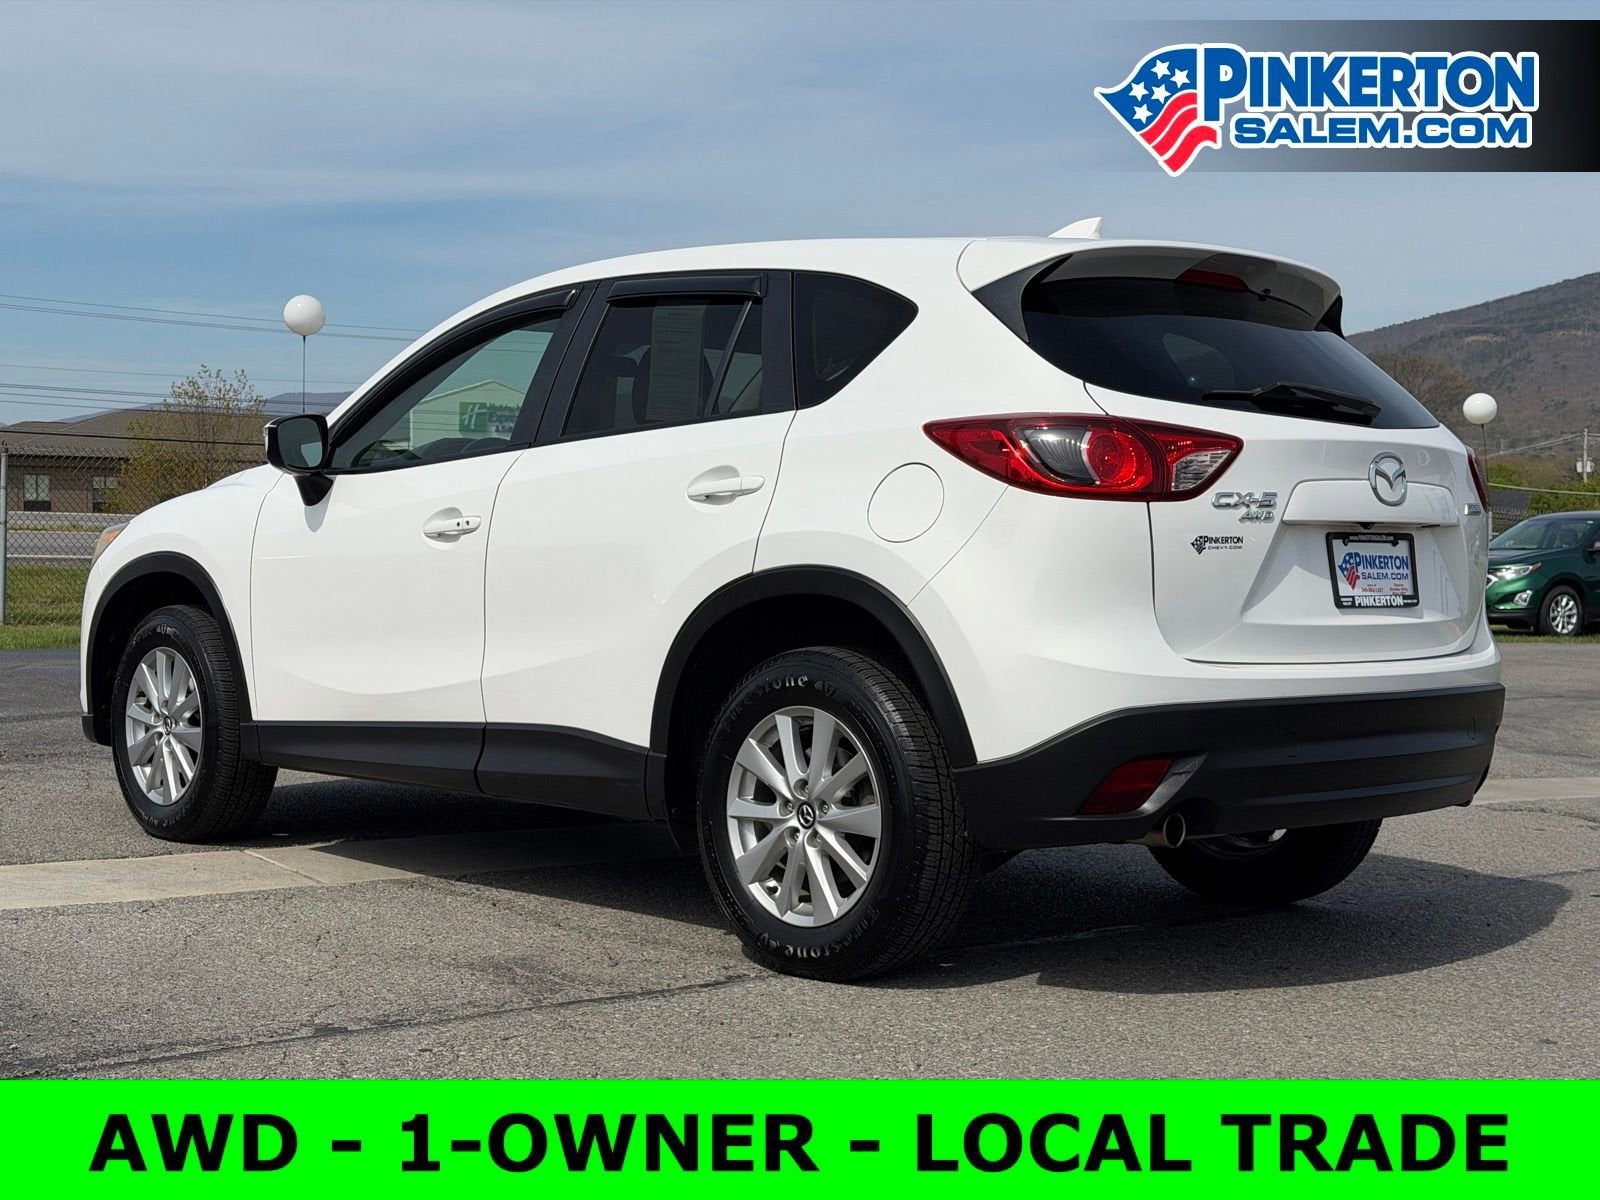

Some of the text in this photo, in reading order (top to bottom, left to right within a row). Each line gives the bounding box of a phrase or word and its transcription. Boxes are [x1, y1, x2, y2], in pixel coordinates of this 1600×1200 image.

[1211, 492, 1277, 509] CX-5
[1239, 510, 1274, 522] AWD
[1204, 536, 1243, 546] PINKERTON
[1354, 552, 1409, 573] PINKERTON
[1362, 572, 1408, 580] SALEM.COM
[1355, 595, 1403, 606] PINKERTON
